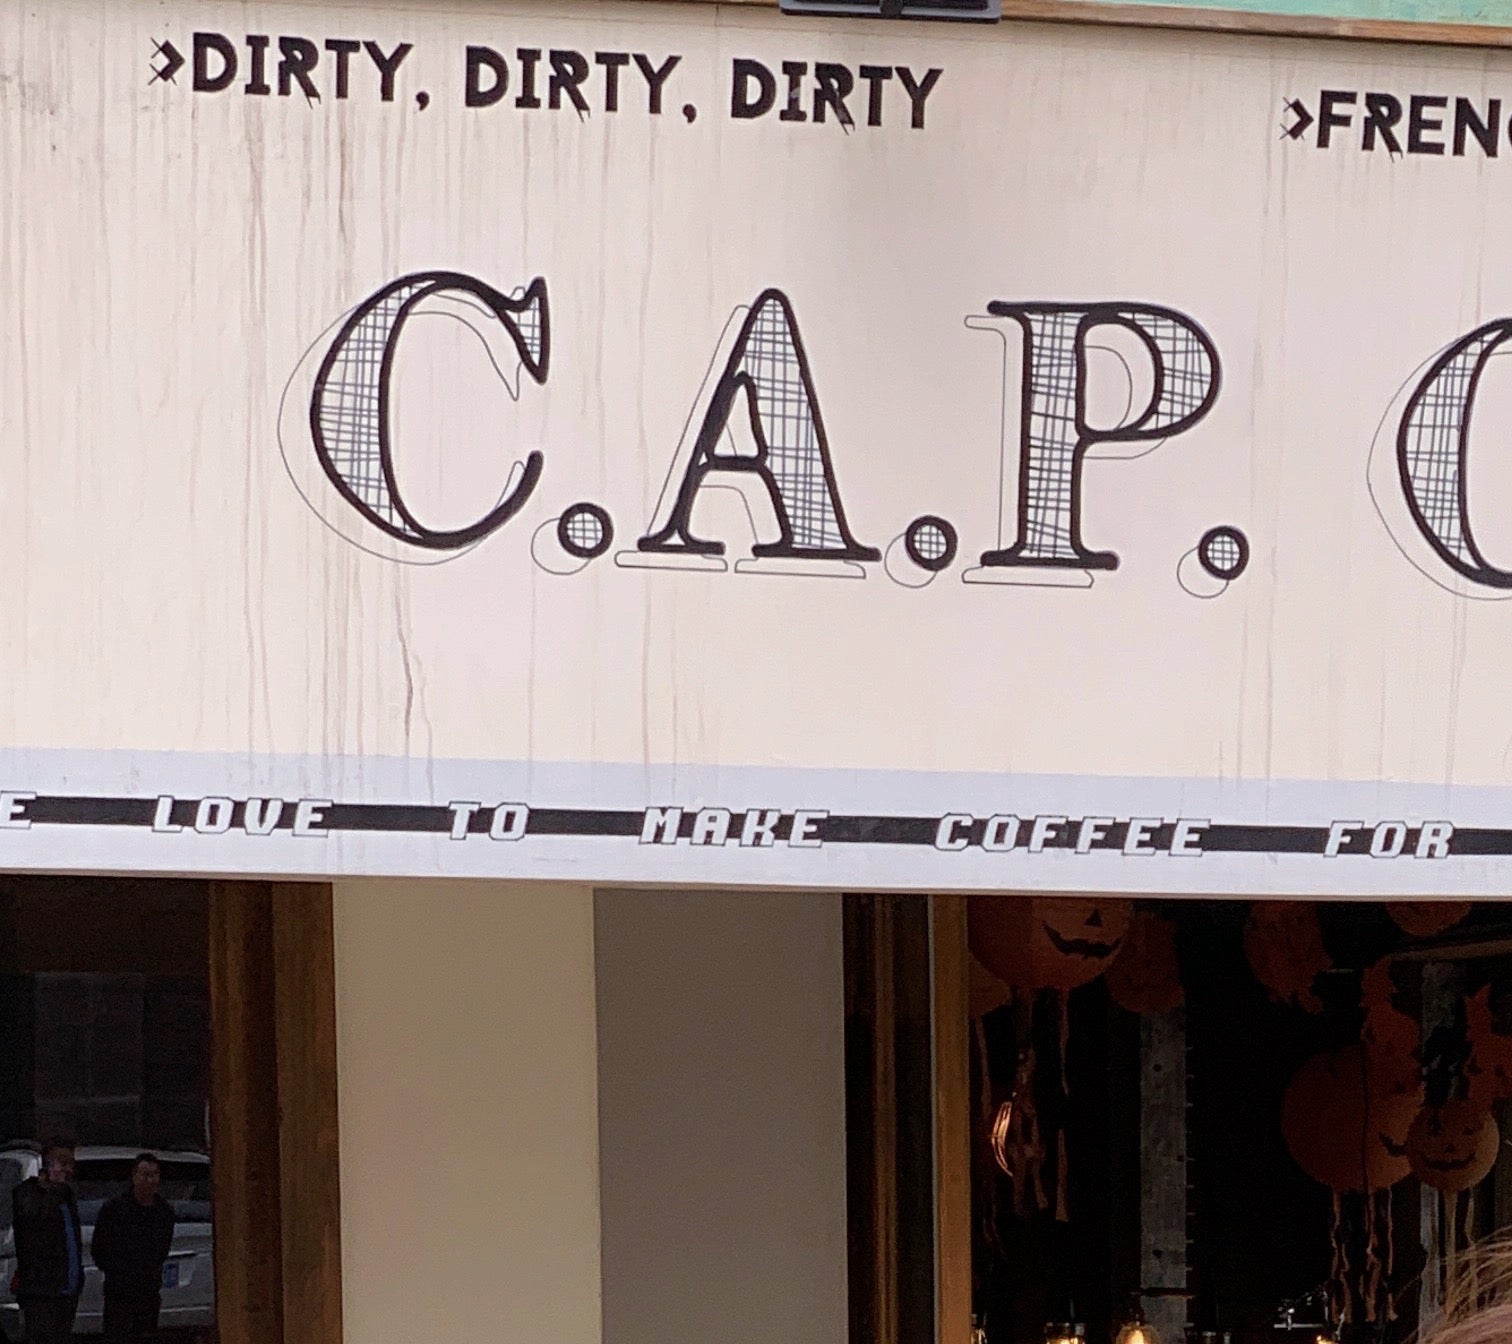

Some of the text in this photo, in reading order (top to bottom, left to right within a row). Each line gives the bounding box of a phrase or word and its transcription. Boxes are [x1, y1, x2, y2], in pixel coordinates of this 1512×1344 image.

[730, 58, 945, 130] DIRTY
[306, 270, 1251, 584] C.A.P.
[0, 791, 37, 829] E
[152, 795, 334, 839] LOVE
[448, 801, 530, 841] TO
[638, 805, 830, 848] MAKE
[934, 811, 1212, 858] COFFEE
[1323, 819, 1455, 860] FOR
